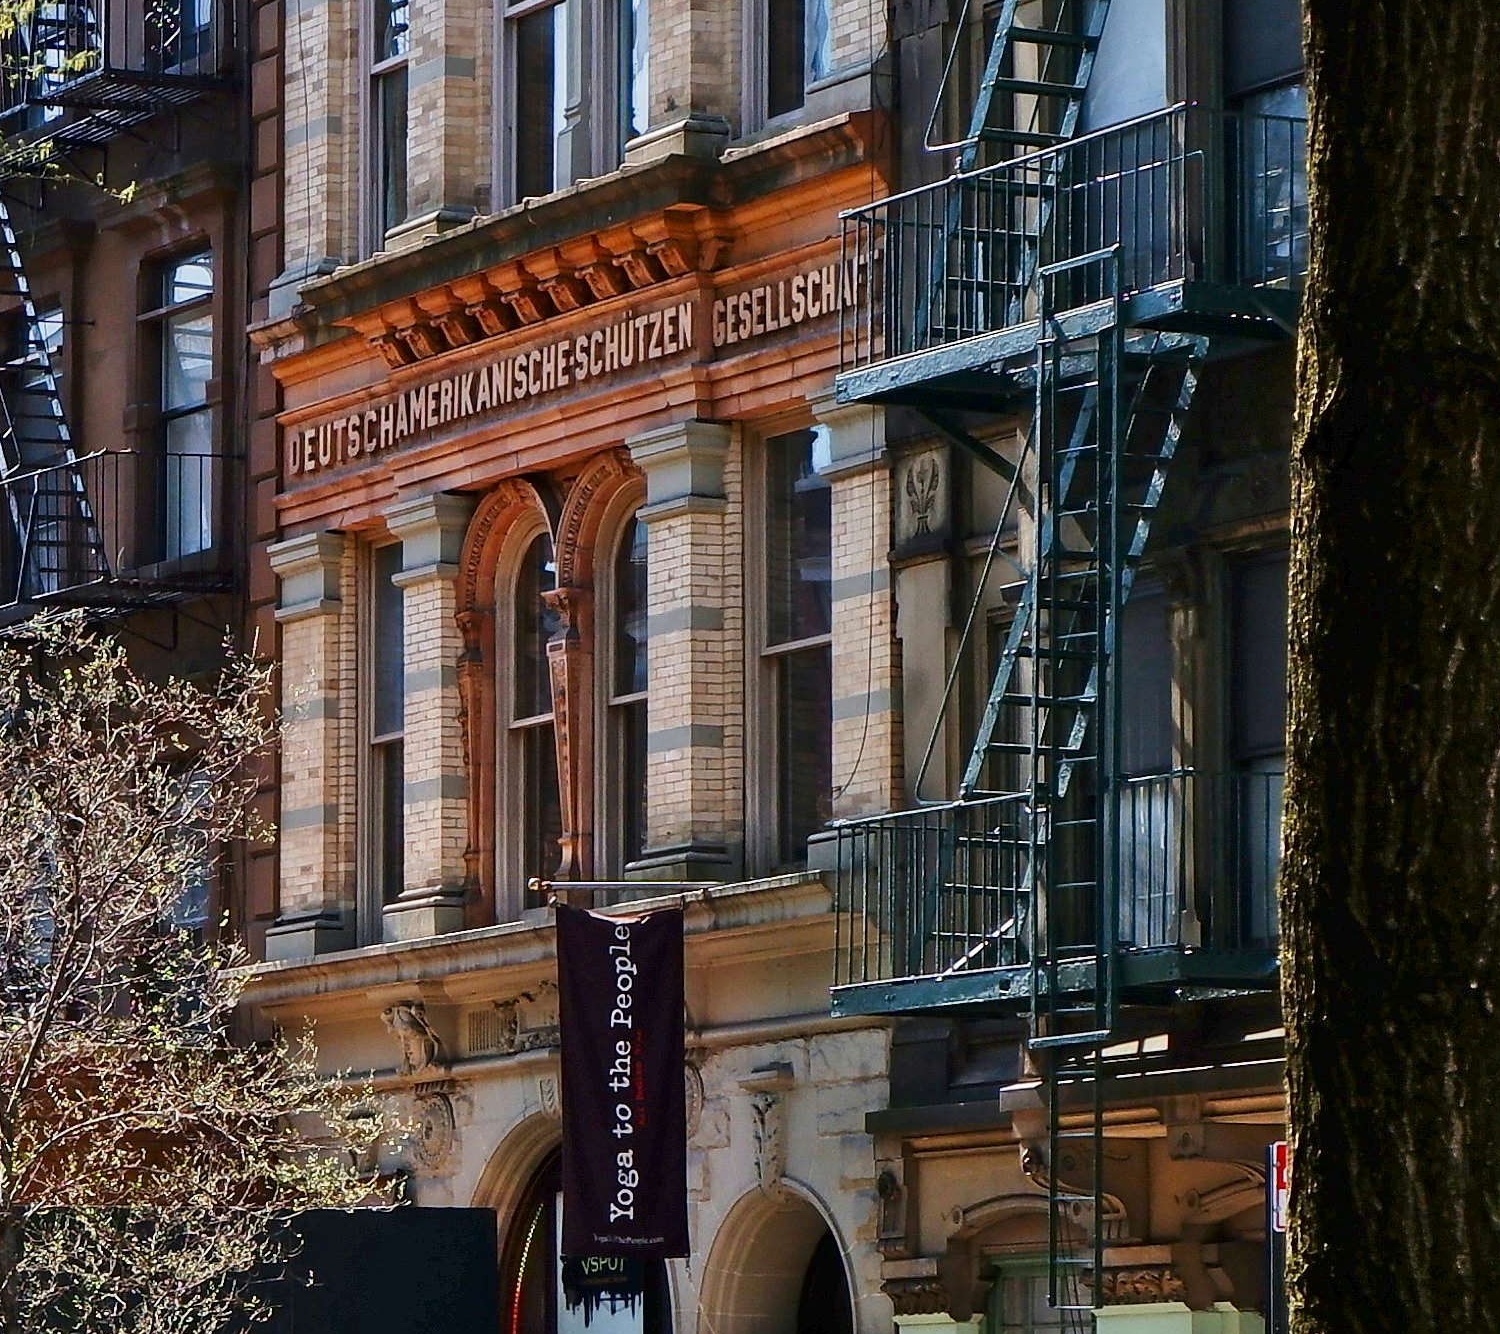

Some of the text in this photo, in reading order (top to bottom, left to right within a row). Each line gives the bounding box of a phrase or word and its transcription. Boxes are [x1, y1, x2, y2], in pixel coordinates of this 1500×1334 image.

[609, 924, 640, 1223] Yoga to the People
